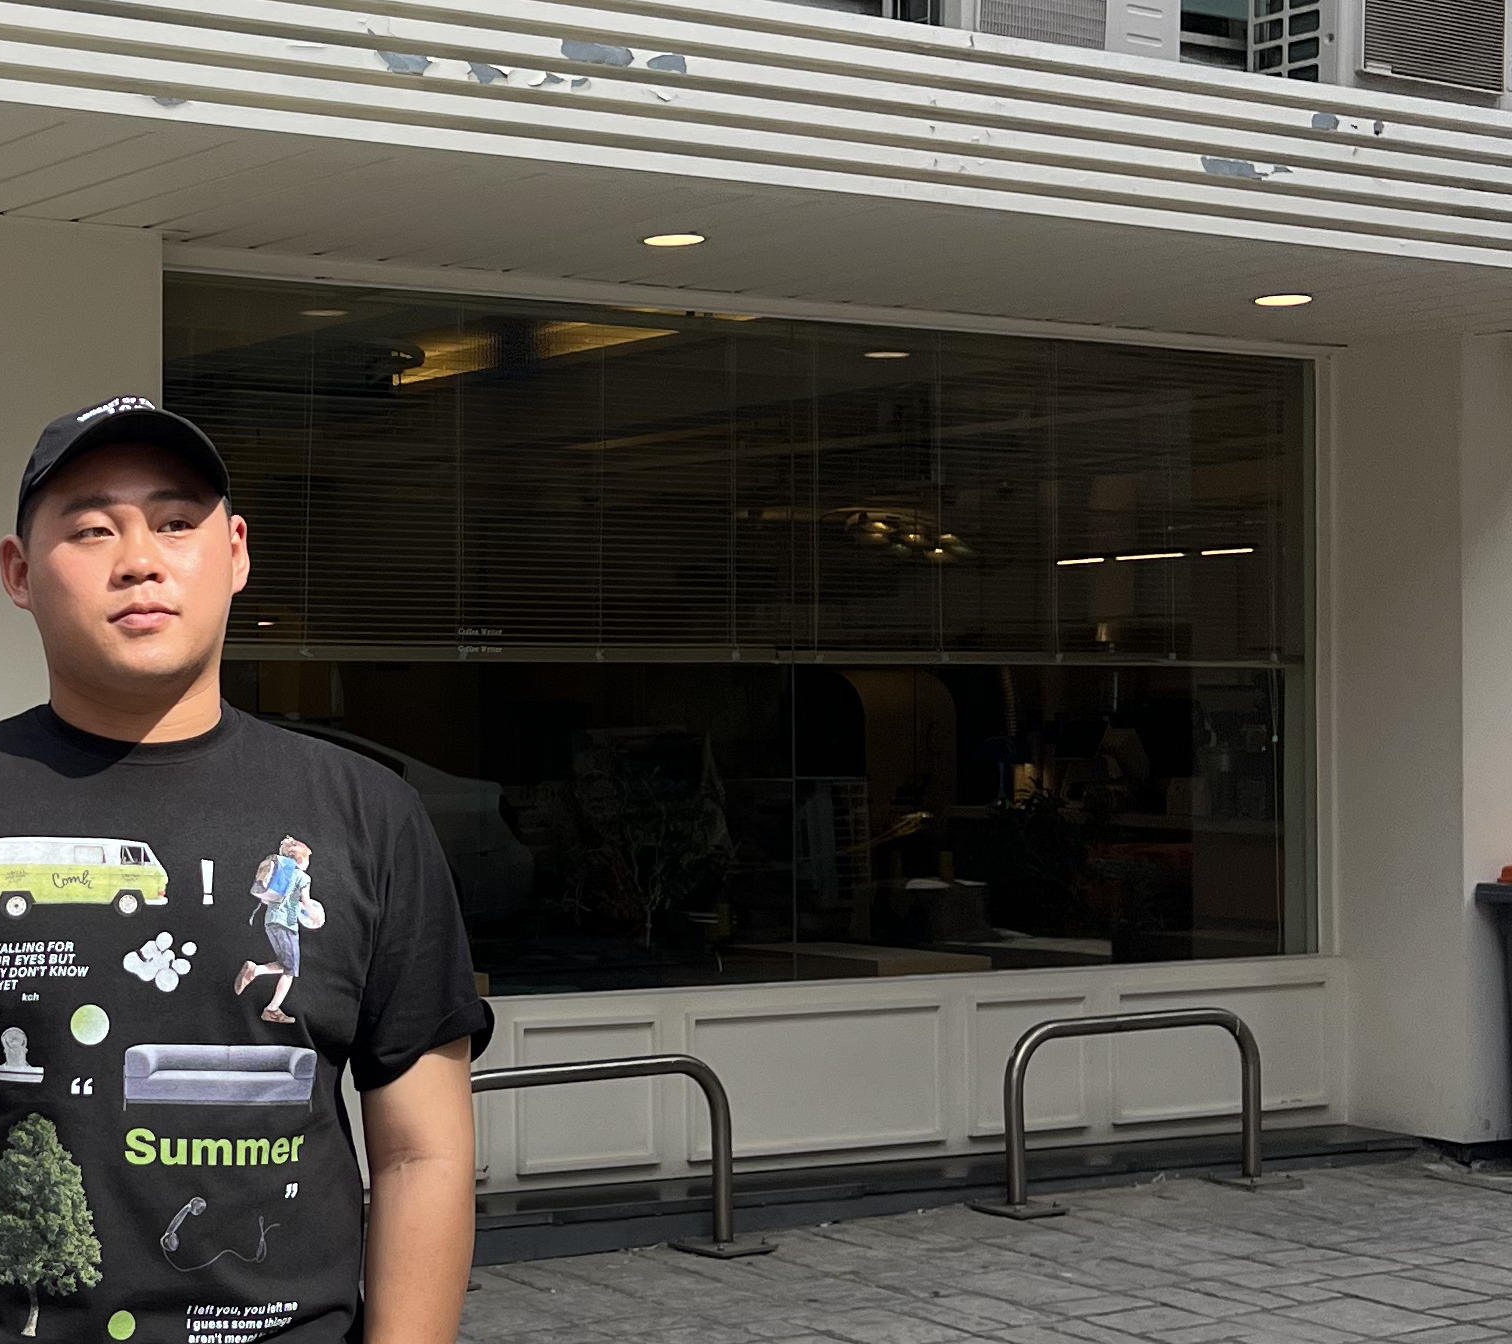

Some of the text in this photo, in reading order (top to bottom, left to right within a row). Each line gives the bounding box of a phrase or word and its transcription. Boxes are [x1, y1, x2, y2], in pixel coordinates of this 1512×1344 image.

[47, 940, 74, 953] FOR
[14, 954, 46, 965] EYES
[48, 953, 76, 965] BUT
[8, 966, 48, 978] DON'T
[49, 965, 89, 977] KNOW
[124, 1127, 305, 1166] Summer
[186, 1301, 299, 1317] I left you, you left me
[186, 1316, 293, 1332] I guess some things
[188, 1332, 223, 1344] aren't
